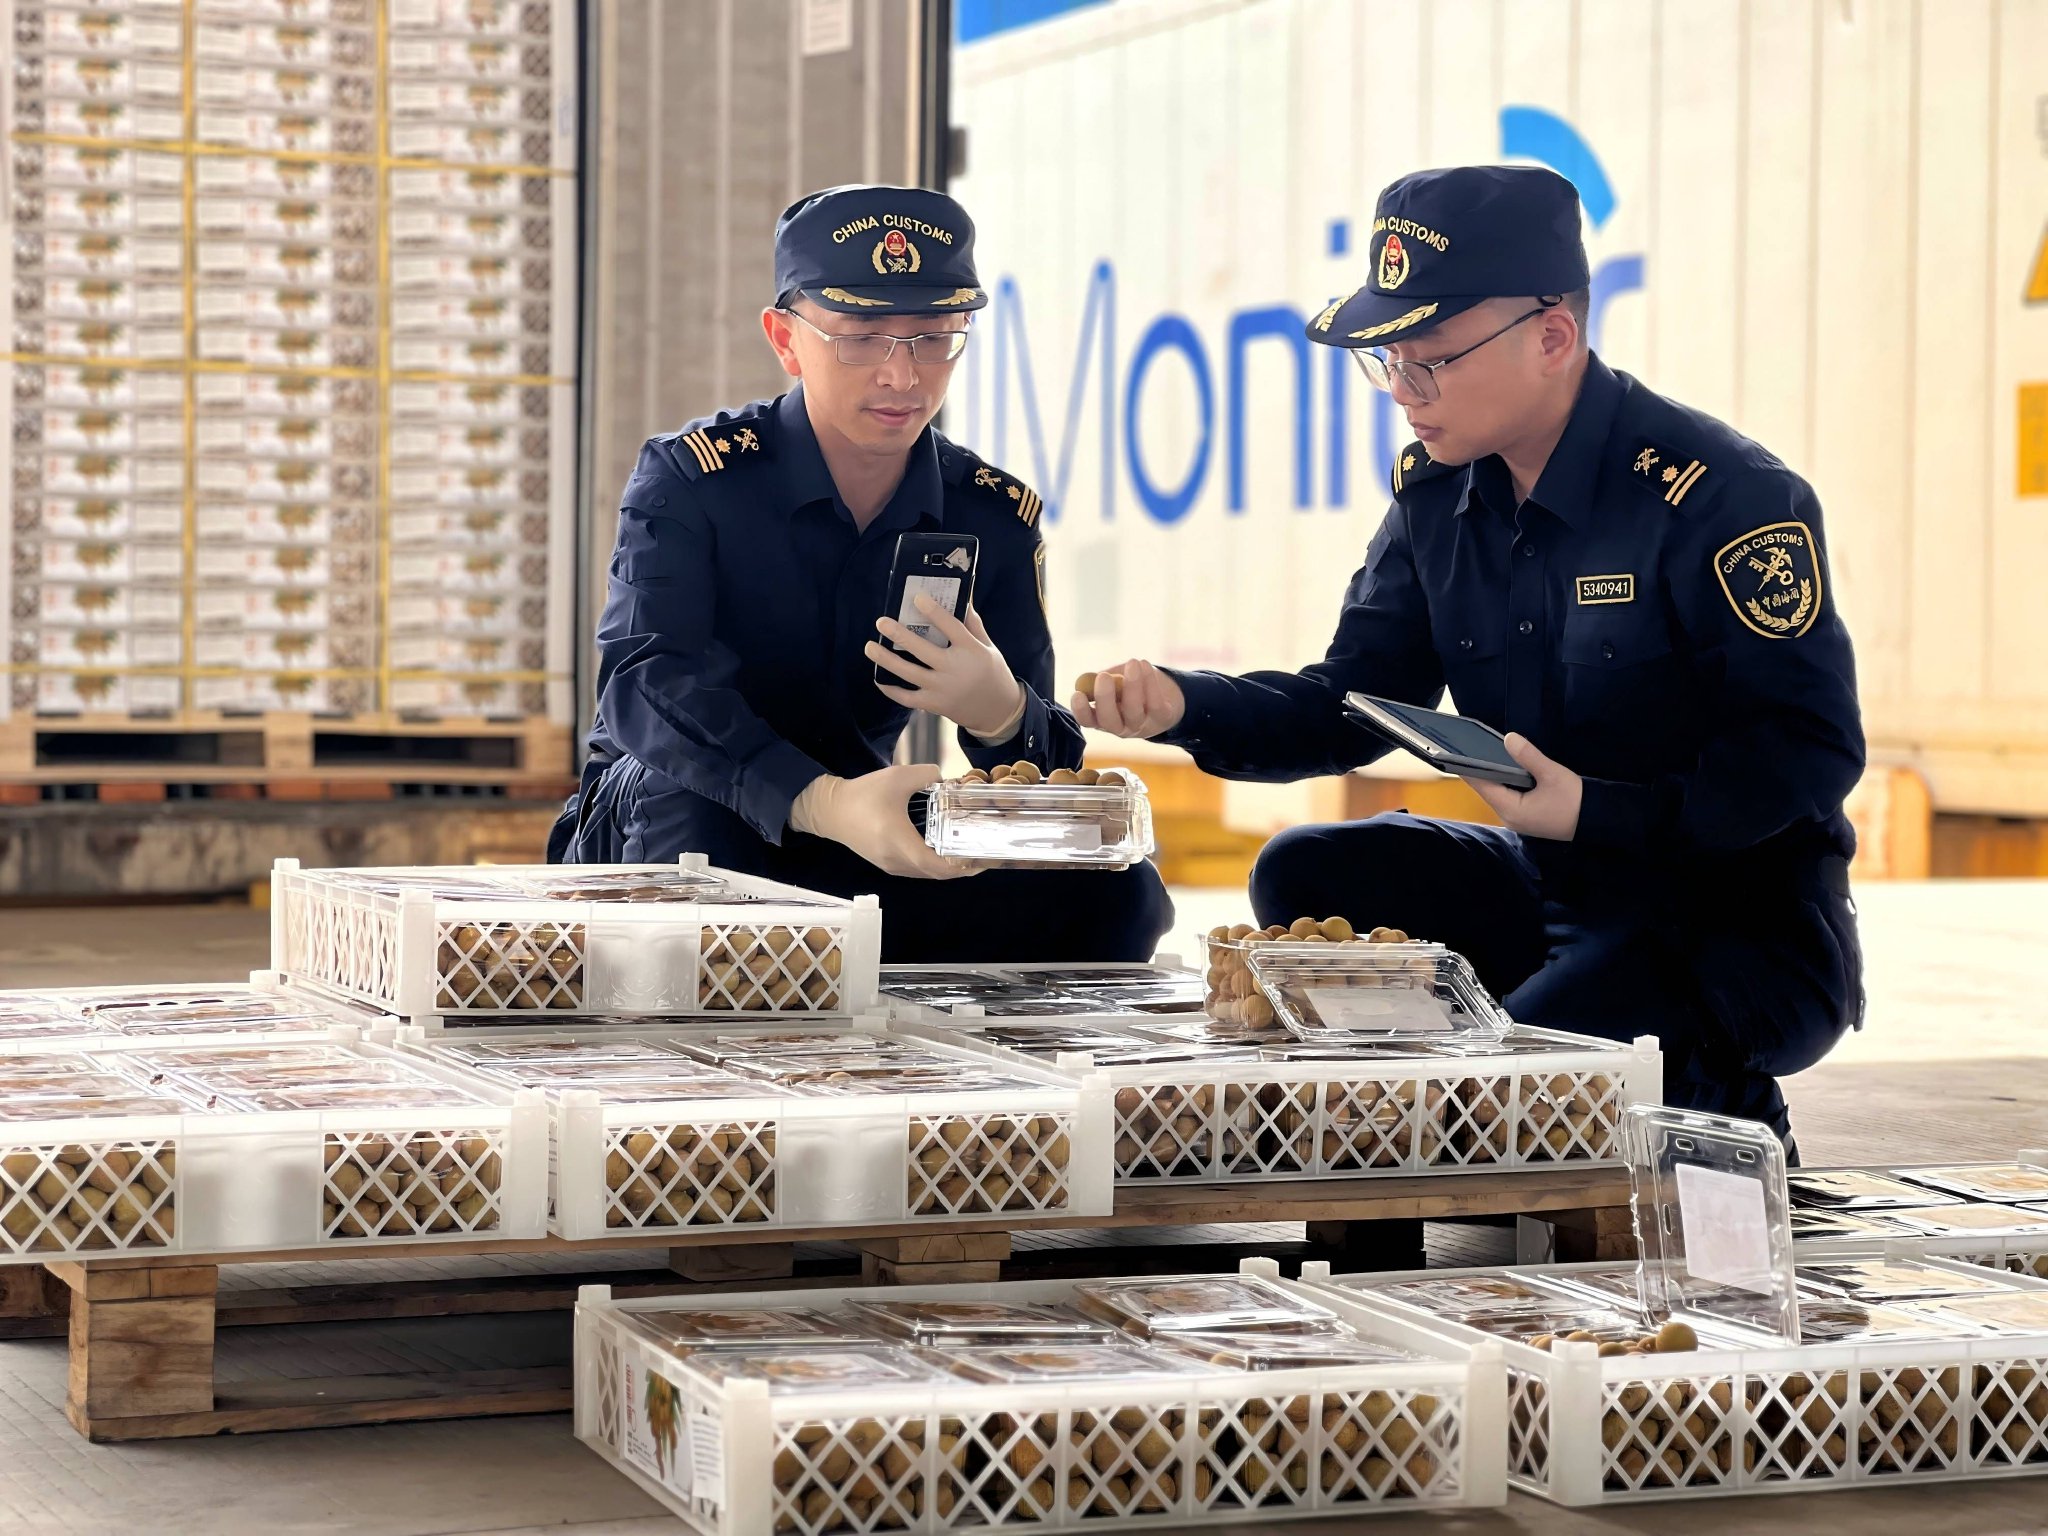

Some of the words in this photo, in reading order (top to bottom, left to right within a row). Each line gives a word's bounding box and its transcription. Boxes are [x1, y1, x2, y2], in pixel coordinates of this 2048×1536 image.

[832, 215, 880, 244] CHINA
[882, 214, 954, 246] CUSTOMS
[1387, 216, 1450, 252] CUSTOMS
[1723, 543, 1752, 574] CHINA
[1752, 533, 1804, 549] CUSTOMS
[1583, 581, 1628, 597] 5340941
